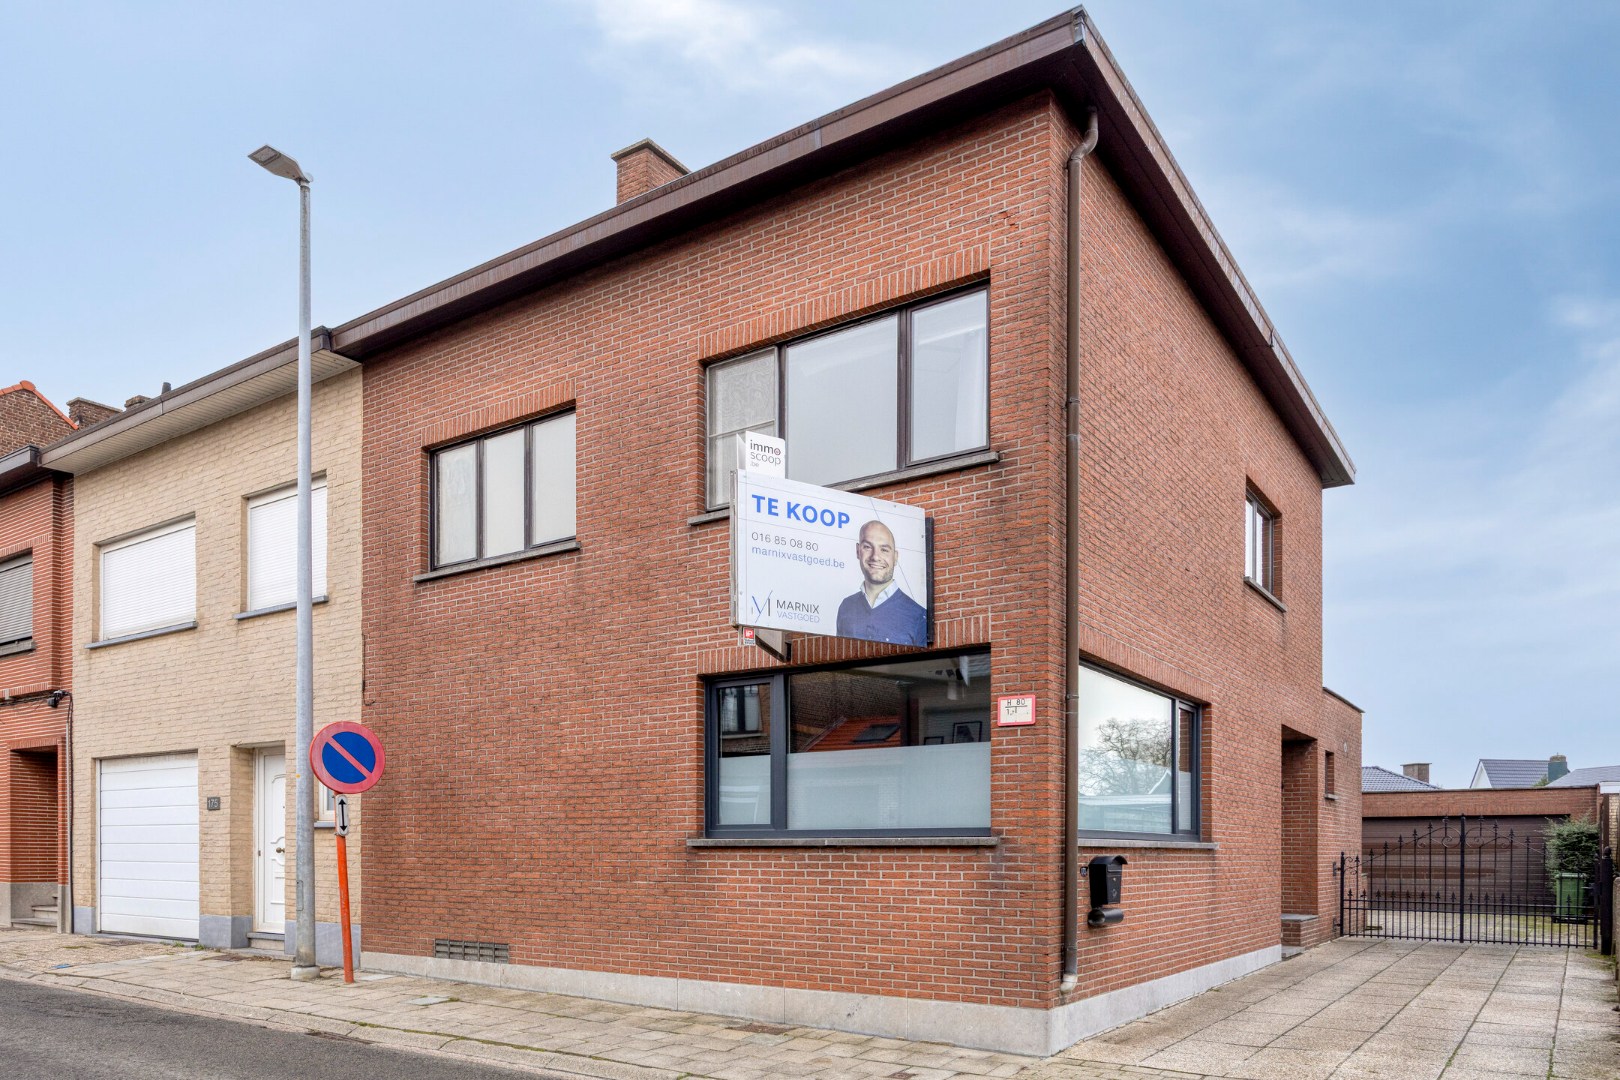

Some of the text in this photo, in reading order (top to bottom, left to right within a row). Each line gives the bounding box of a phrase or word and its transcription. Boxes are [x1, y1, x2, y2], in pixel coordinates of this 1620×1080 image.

[750, 452, 781, 467] scoop
[752, 494, 850, 529] TE KOOP
[752, 532, 819, 552] 016 85 08 80
[752, 546, 845, 569] marnixvastgoed.be
[776, 599, 820, 614] MARNIX
[777, 610, 820, 624] VASTGOED
[208, 799, 219, 808] 175
